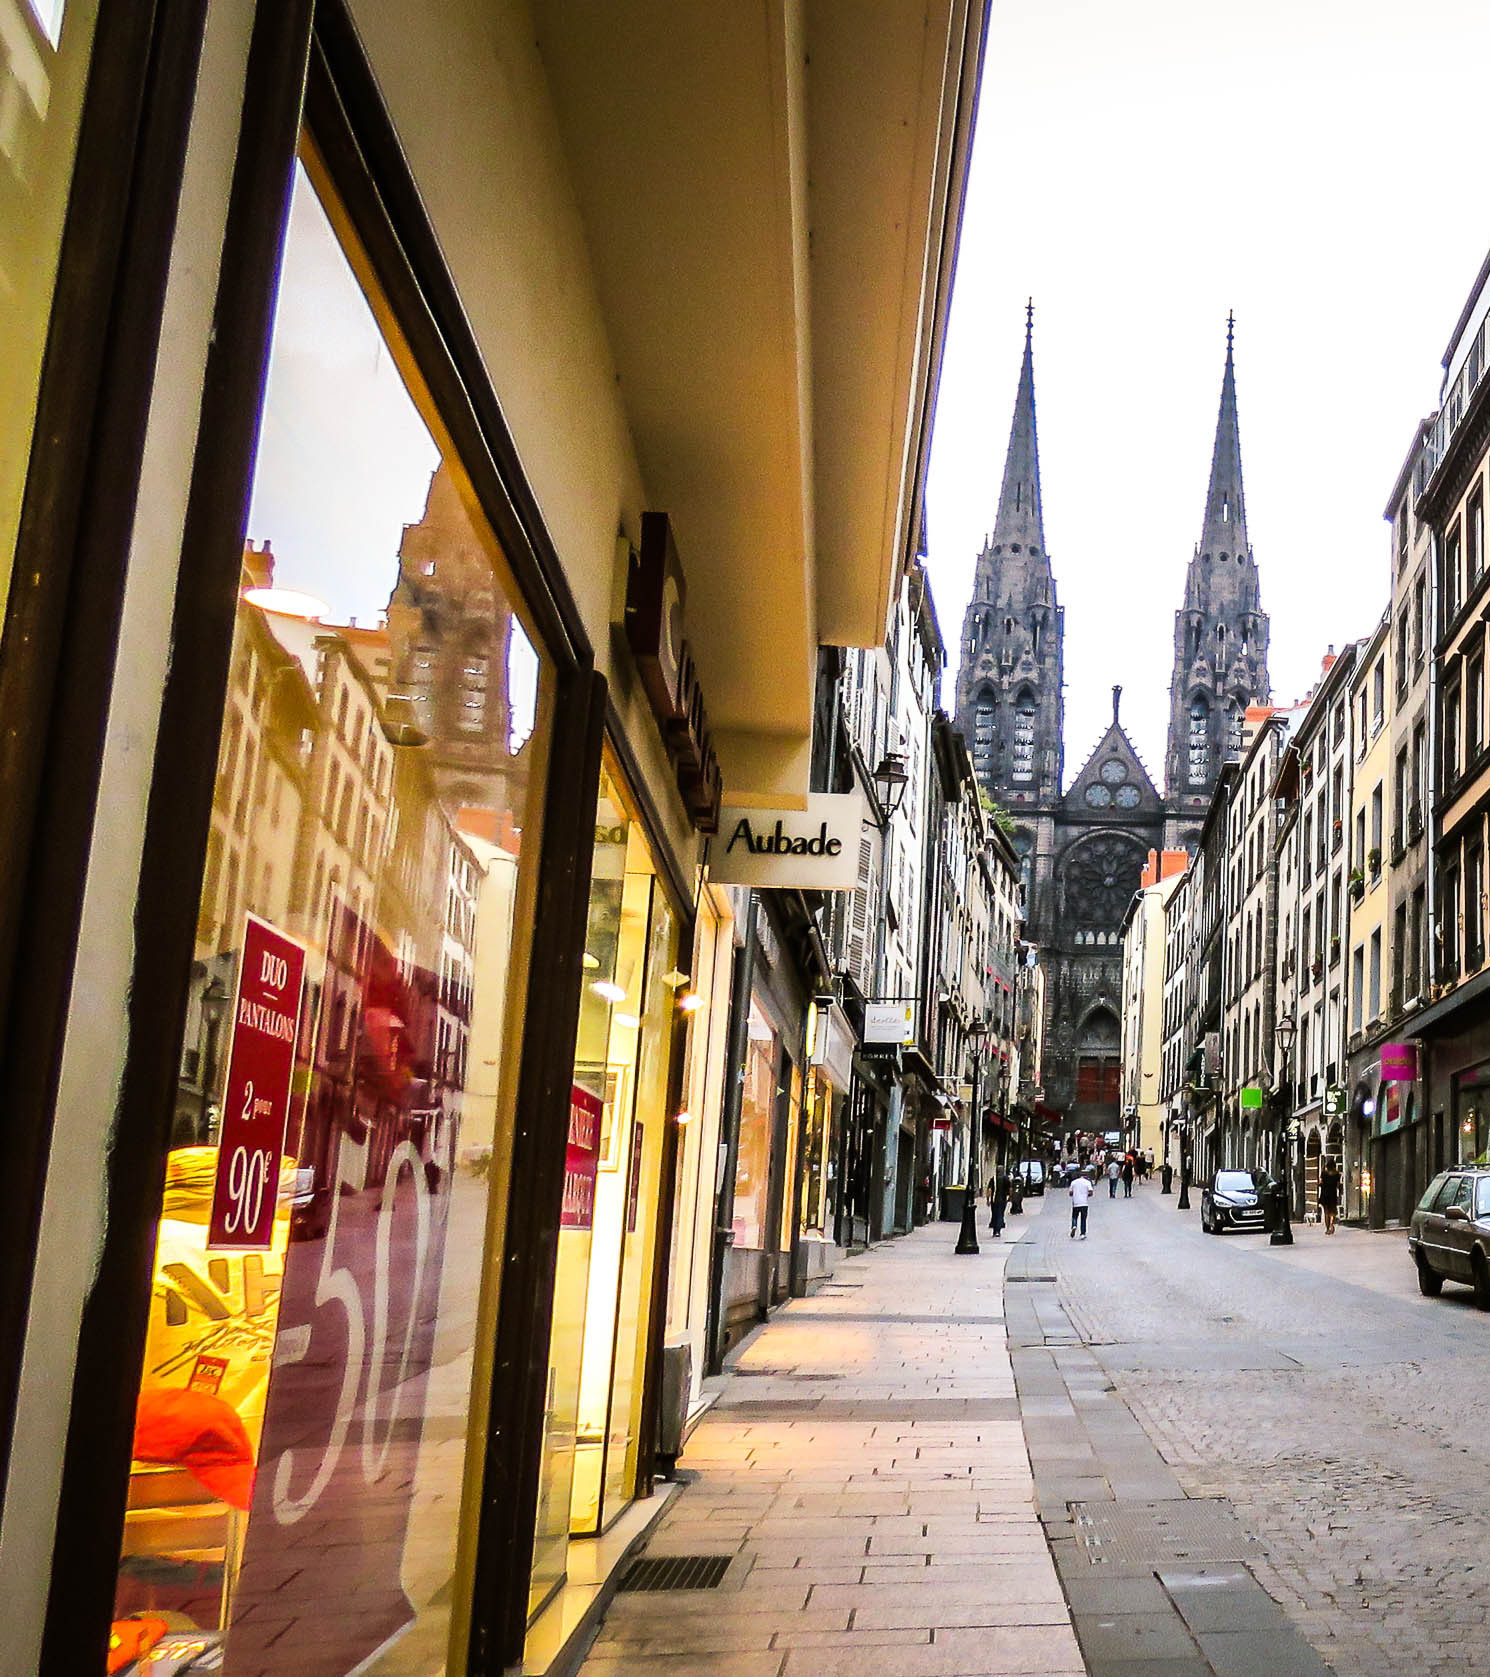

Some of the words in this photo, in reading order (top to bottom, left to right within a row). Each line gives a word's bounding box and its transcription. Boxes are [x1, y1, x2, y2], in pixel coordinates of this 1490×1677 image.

[726, 818, 842, 857] Aubade
[260, 950, 288, 992] DUO
[239, 997, 295, 1043] PANTALONS
[241, 1080, 254, 1121] 2
[252, 1096, 273, 1120] pour
